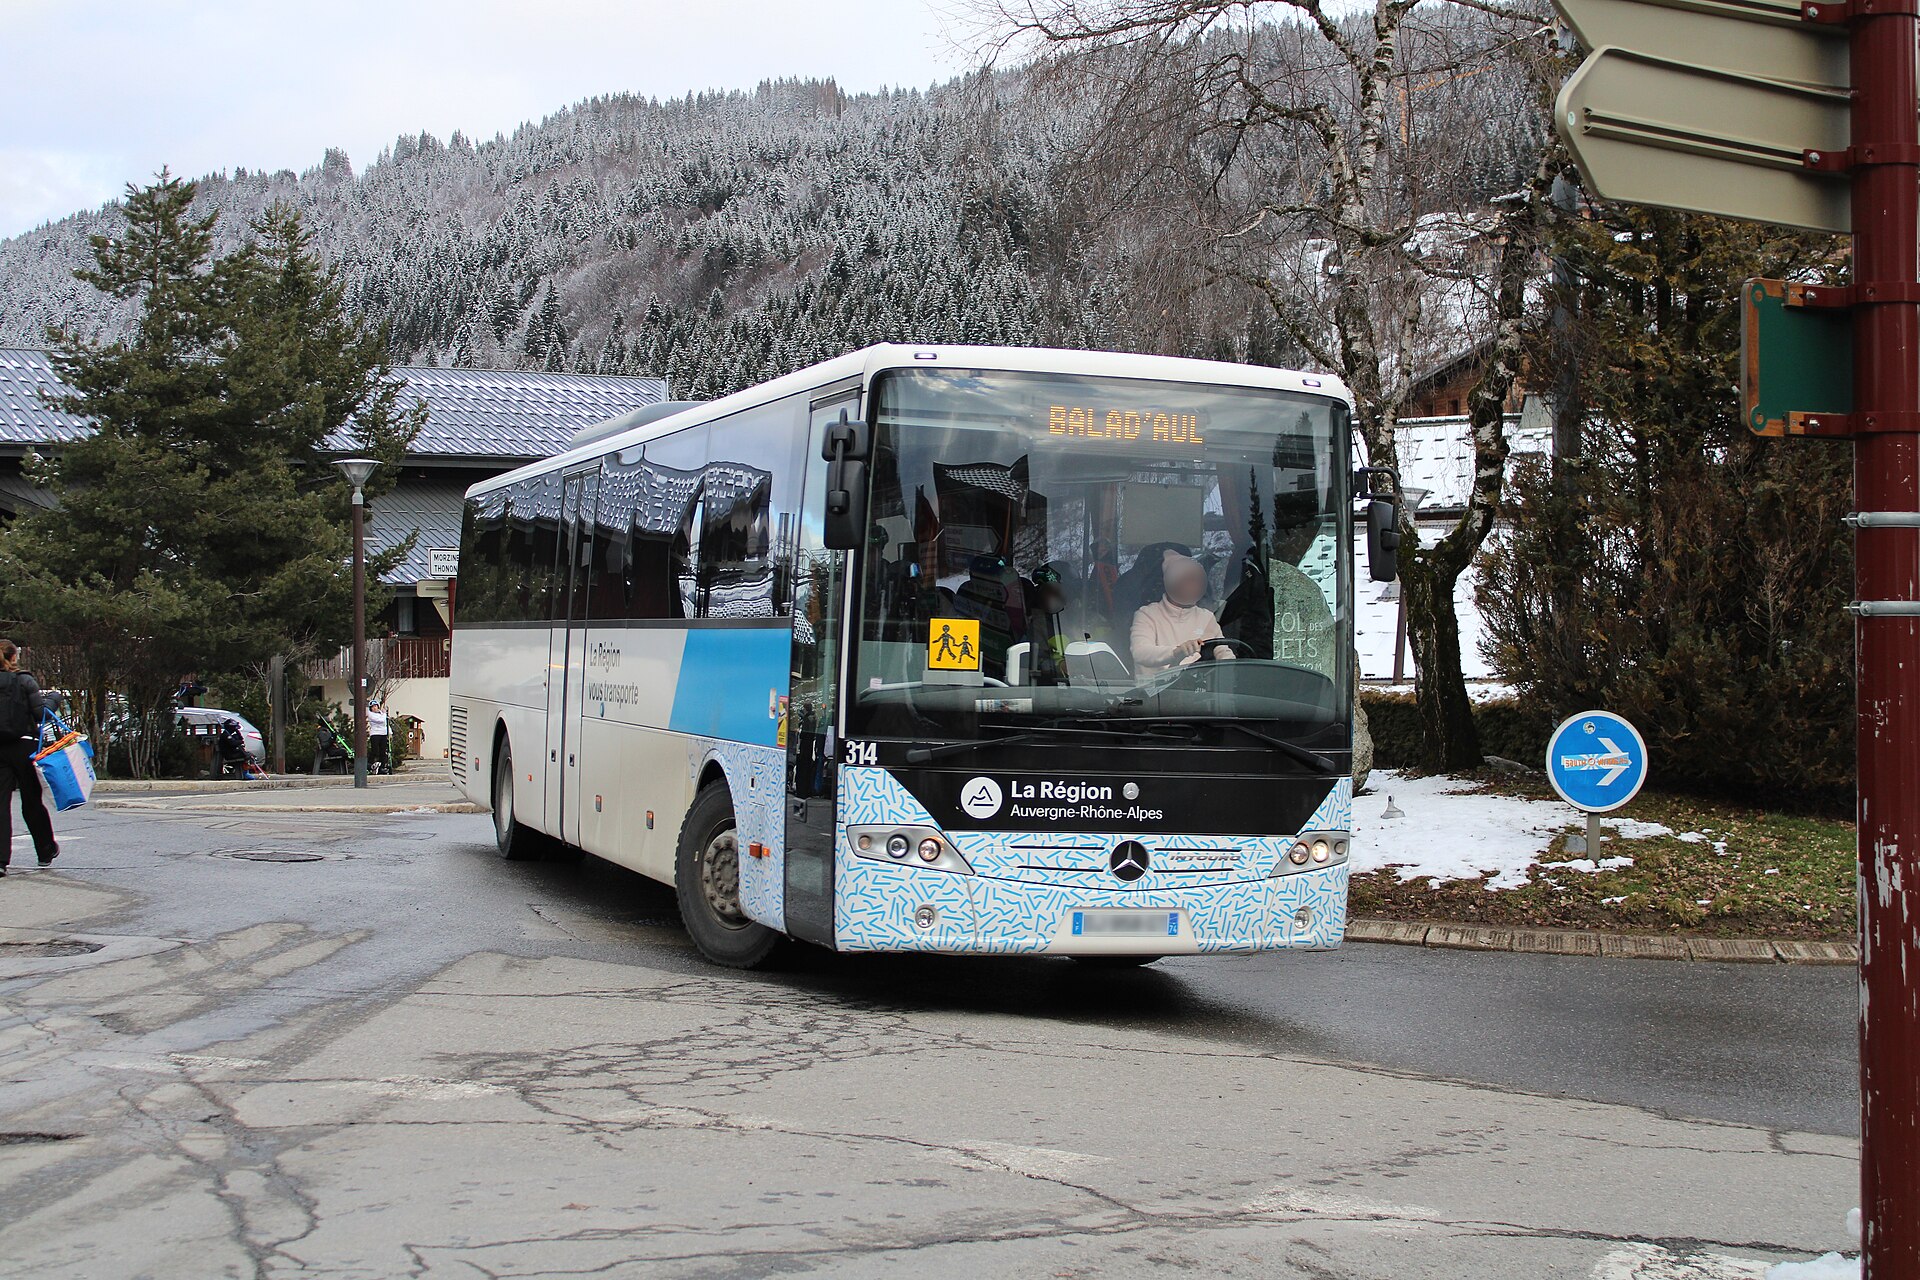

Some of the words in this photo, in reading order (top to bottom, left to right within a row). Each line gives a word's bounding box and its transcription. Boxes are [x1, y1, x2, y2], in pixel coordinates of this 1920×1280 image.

[1049, 405, 1203, 444] BALAD'AUL
[434, 564, 458, 573] THONON
[1309, 621, 1323, 631] DES
[589, 642, 598, 667] La
[599, 641, 621, 673] Région
[589, 682, 603, 701] vous
[604, 680, 639, 709] transporte
[845, 740, 878, 765] 314
[1011, 781, 1035, 799] La
[1040, 780, 1113, 803] Région
[1010, 804, 1163, 822] Auvergne-Rhône-Alpes
[1168, 924, 1177, 934] 74
